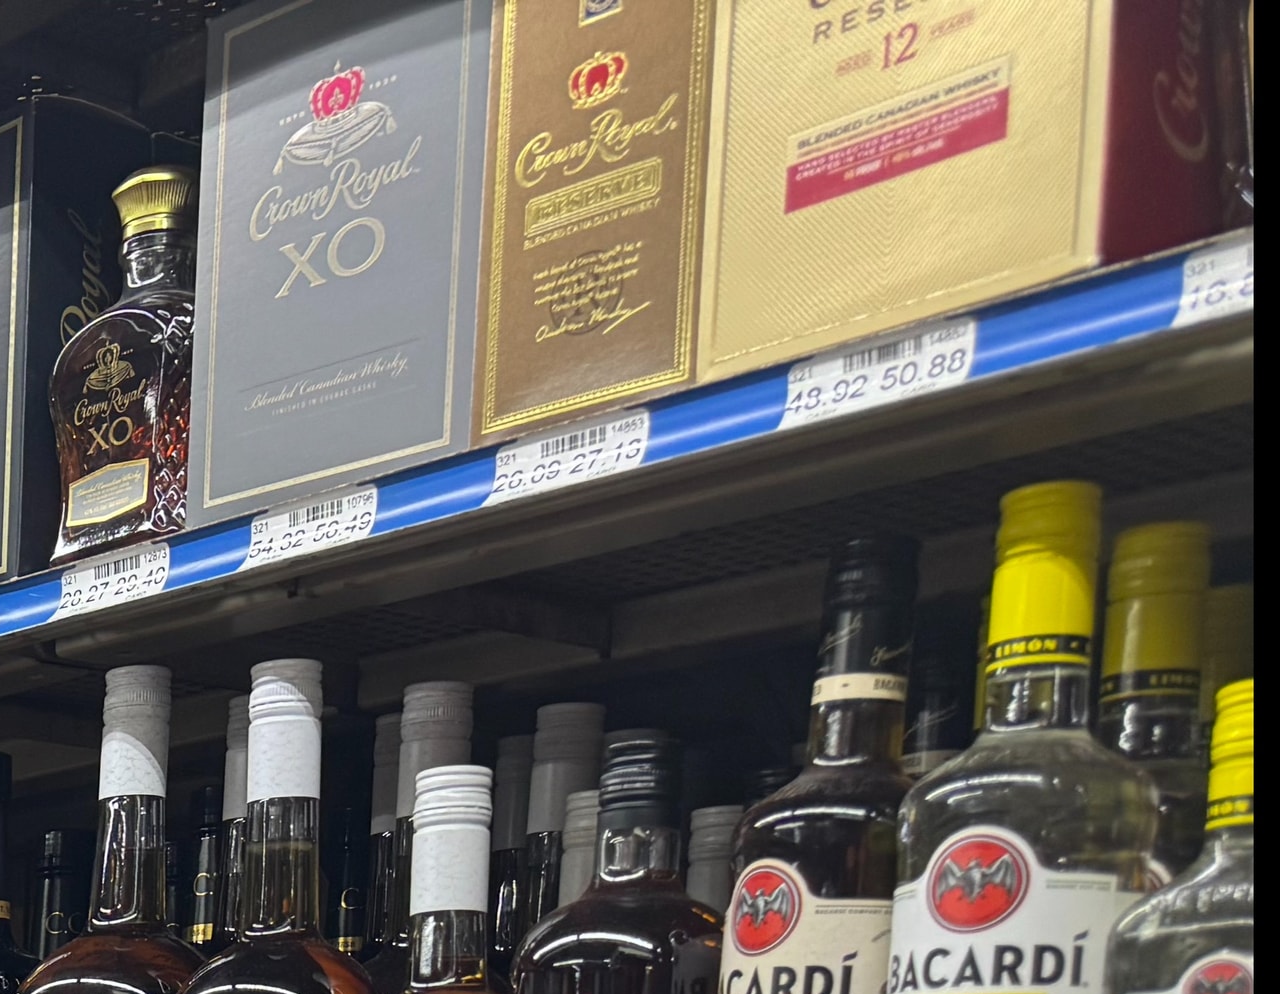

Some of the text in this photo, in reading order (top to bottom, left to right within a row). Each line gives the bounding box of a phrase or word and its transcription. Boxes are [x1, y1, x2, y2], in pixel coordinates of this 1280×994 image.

[882, 22, 918, 70] 12
[942, 67, 1001, 96] WHISKY
[515, 93, 673, 188] Crown Royal
[250, 135, 416, 241] Crown Royal
[275, 217, 385, 299] XO
[244, 352, 408, 411] Blended Canadian Whisky
[880, 349, 966, 392] 50.88
[74, 379, 145, 426] Crown Royal
[86, 415, 132, 455] XO
[891, 929, 1084, 994] BACARDÍ
